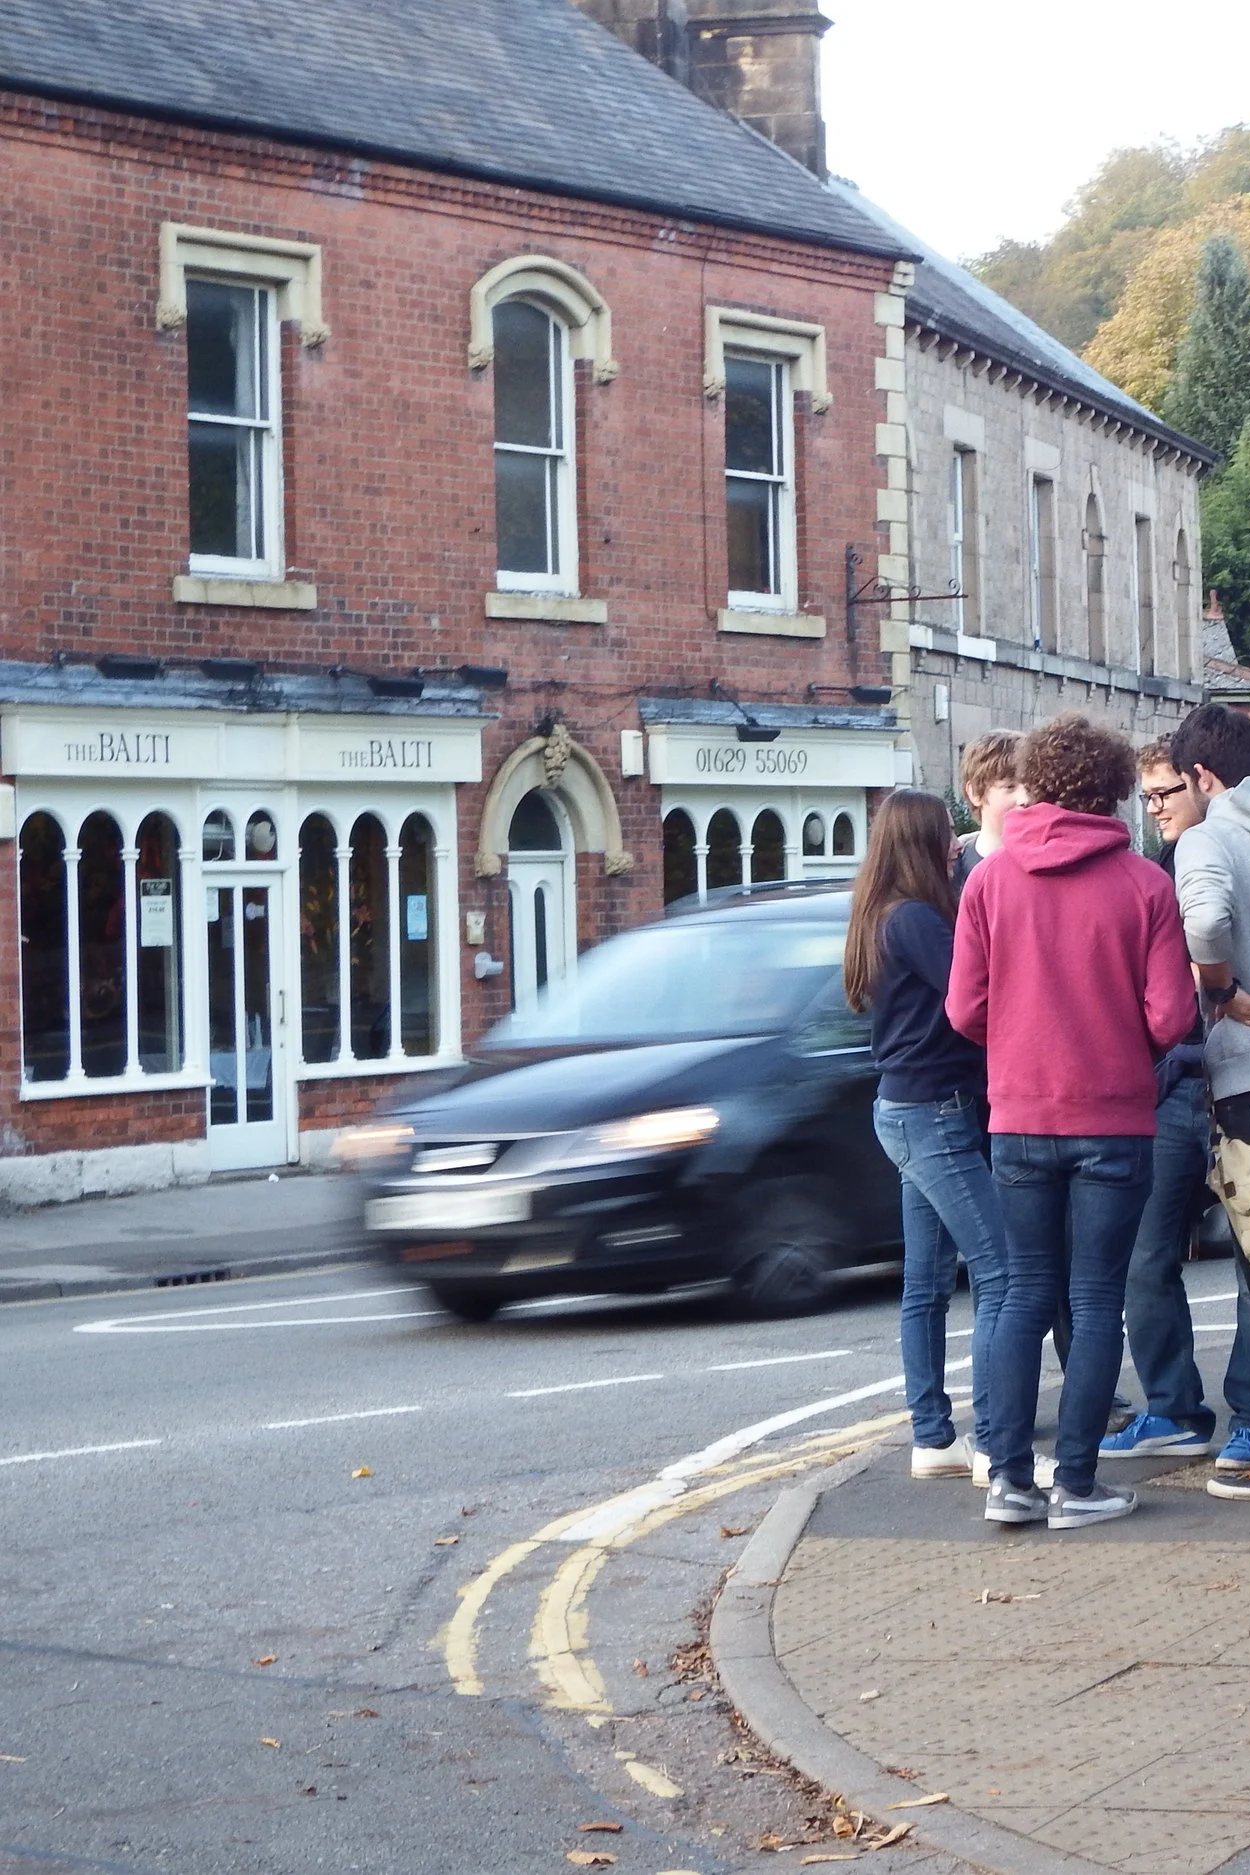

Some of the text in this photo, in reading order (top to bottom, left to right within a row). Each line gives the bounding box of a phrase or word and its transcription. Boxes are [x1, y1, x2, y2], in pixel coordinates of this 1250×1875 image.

[64, 733, 172, 764] THE BALTI
[339, 740, 433, 769] THE BALTI
[696, 747, 808, 775] 01629 55069
